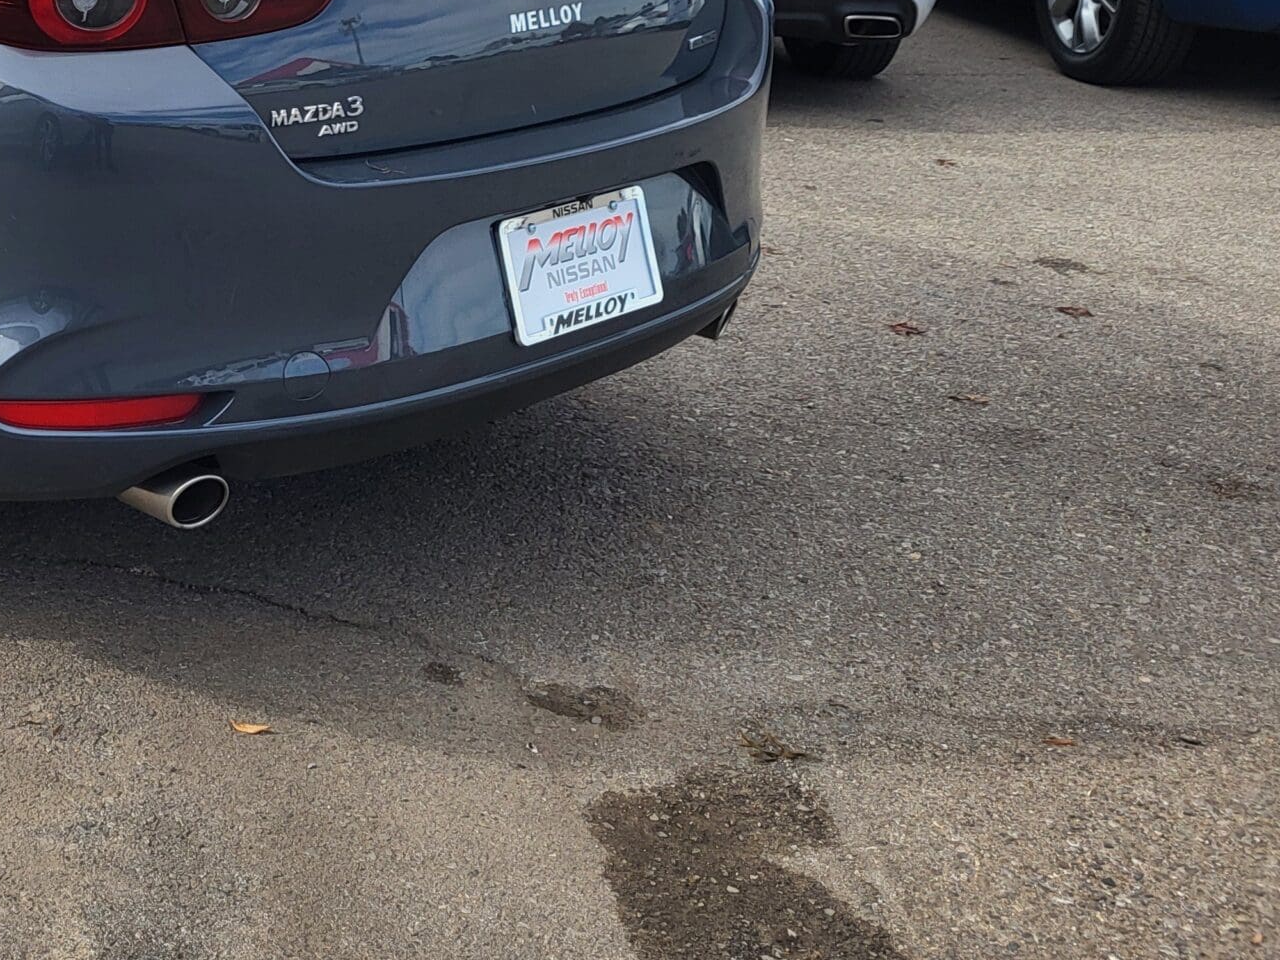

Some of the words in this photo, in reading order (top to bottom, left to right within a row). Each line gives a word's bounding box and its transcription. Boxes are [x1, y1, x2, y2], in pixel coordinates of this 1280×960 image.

[510, 2, 583, 33] MELLOY
[317, 120, 359, 137] AWD
[552, 199, 594, 218] NISSAN
[520, 212, 634, 292] MELLOY
[547, 254, 616, 289] NISSAN
[554, 293, 628, 334] MELLOY
